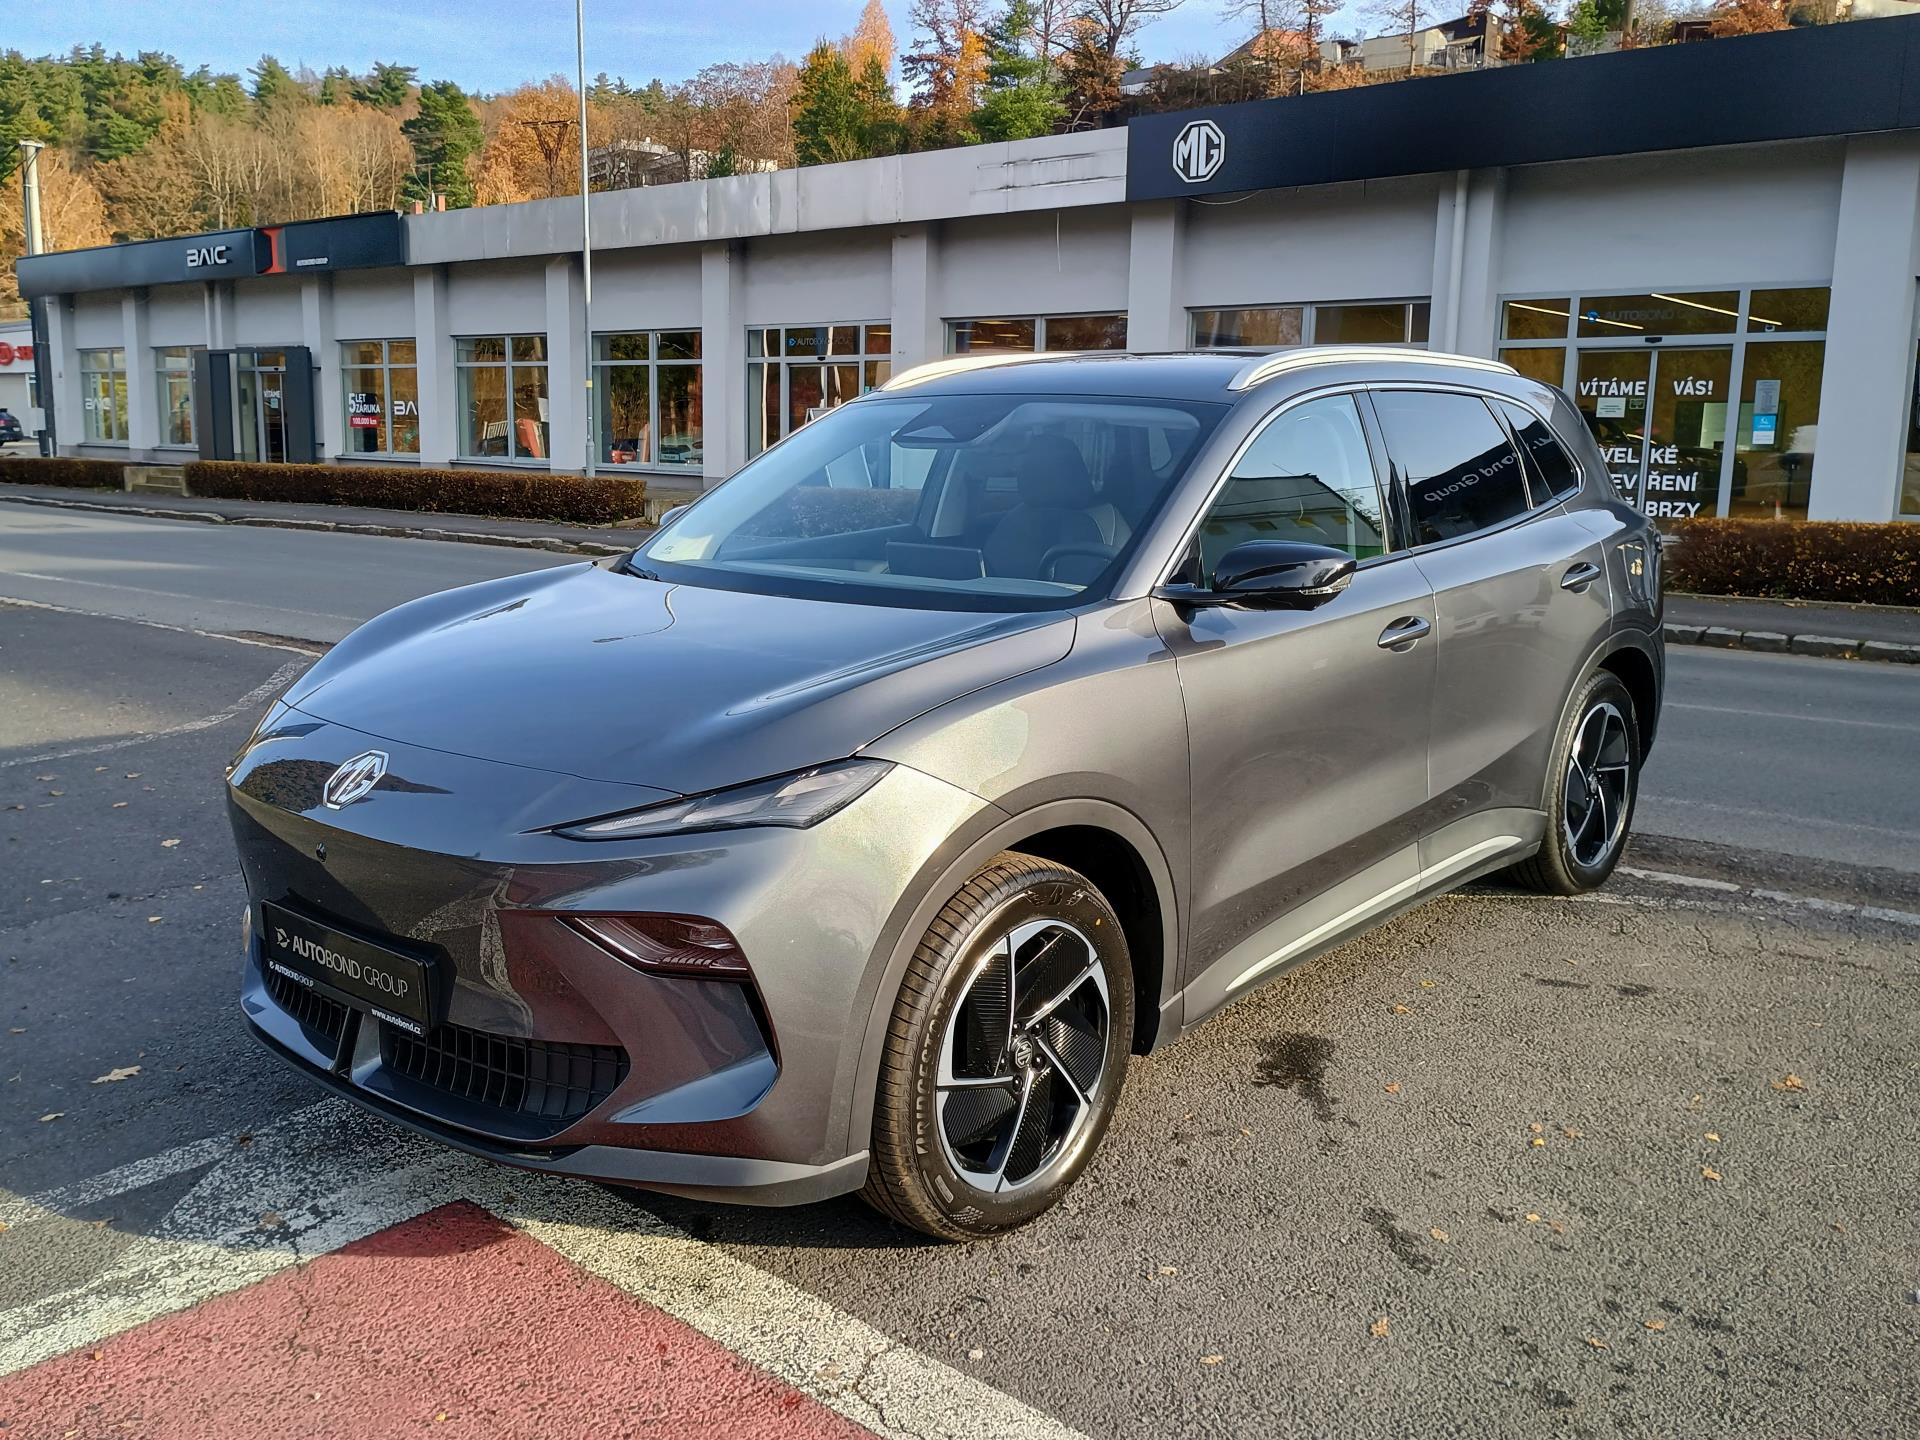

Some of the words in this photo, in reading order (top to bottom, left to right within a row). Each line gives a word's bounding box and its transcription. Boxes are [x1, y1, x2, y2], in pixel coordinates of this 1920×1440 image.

[1177, 125, 1220, 177] MG
[187, 245, 227, 267] BAIC
[1580, 377, 1647, 396] VÍTÁME
[1673, 376, 1713, 396] VÁS!
[348, 393, 356, 413] 5
[356, 394, 366, 402] LET
[394, 400, 417, 415] BA
[1645, 501, 1700, 518] BRZY
[329, 755, 382, 804] MG
[292, 936, 361, 979] AUTOBOND
[363, 966, 408, 998] GROUP
[371, 1008, 422, 1035] www.autobond.cz
